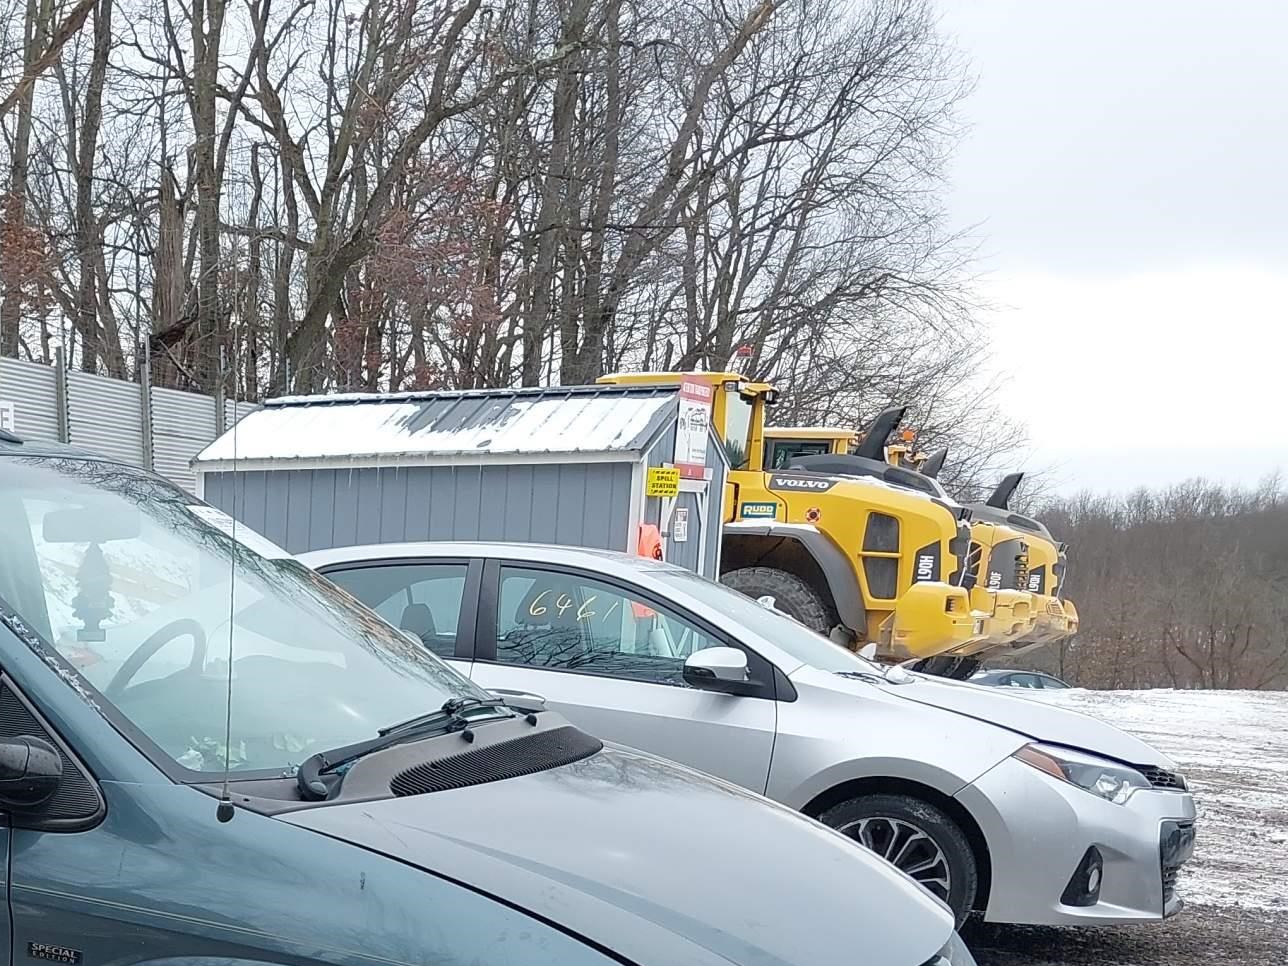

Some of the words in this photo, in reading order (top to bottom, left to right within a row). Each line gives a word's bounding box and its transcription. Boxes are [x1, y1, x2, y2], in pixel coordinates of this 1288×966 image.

[776, 479, 829, 489] VOLVO
[743, 505, 774, 515] RUDD
[917, 555, 935, 580] L90H
[1029, 574, 1041, 592] L90H
[32, 943, 77, 959] SPECIAL
[32, 950, 75, 964] EDITION
